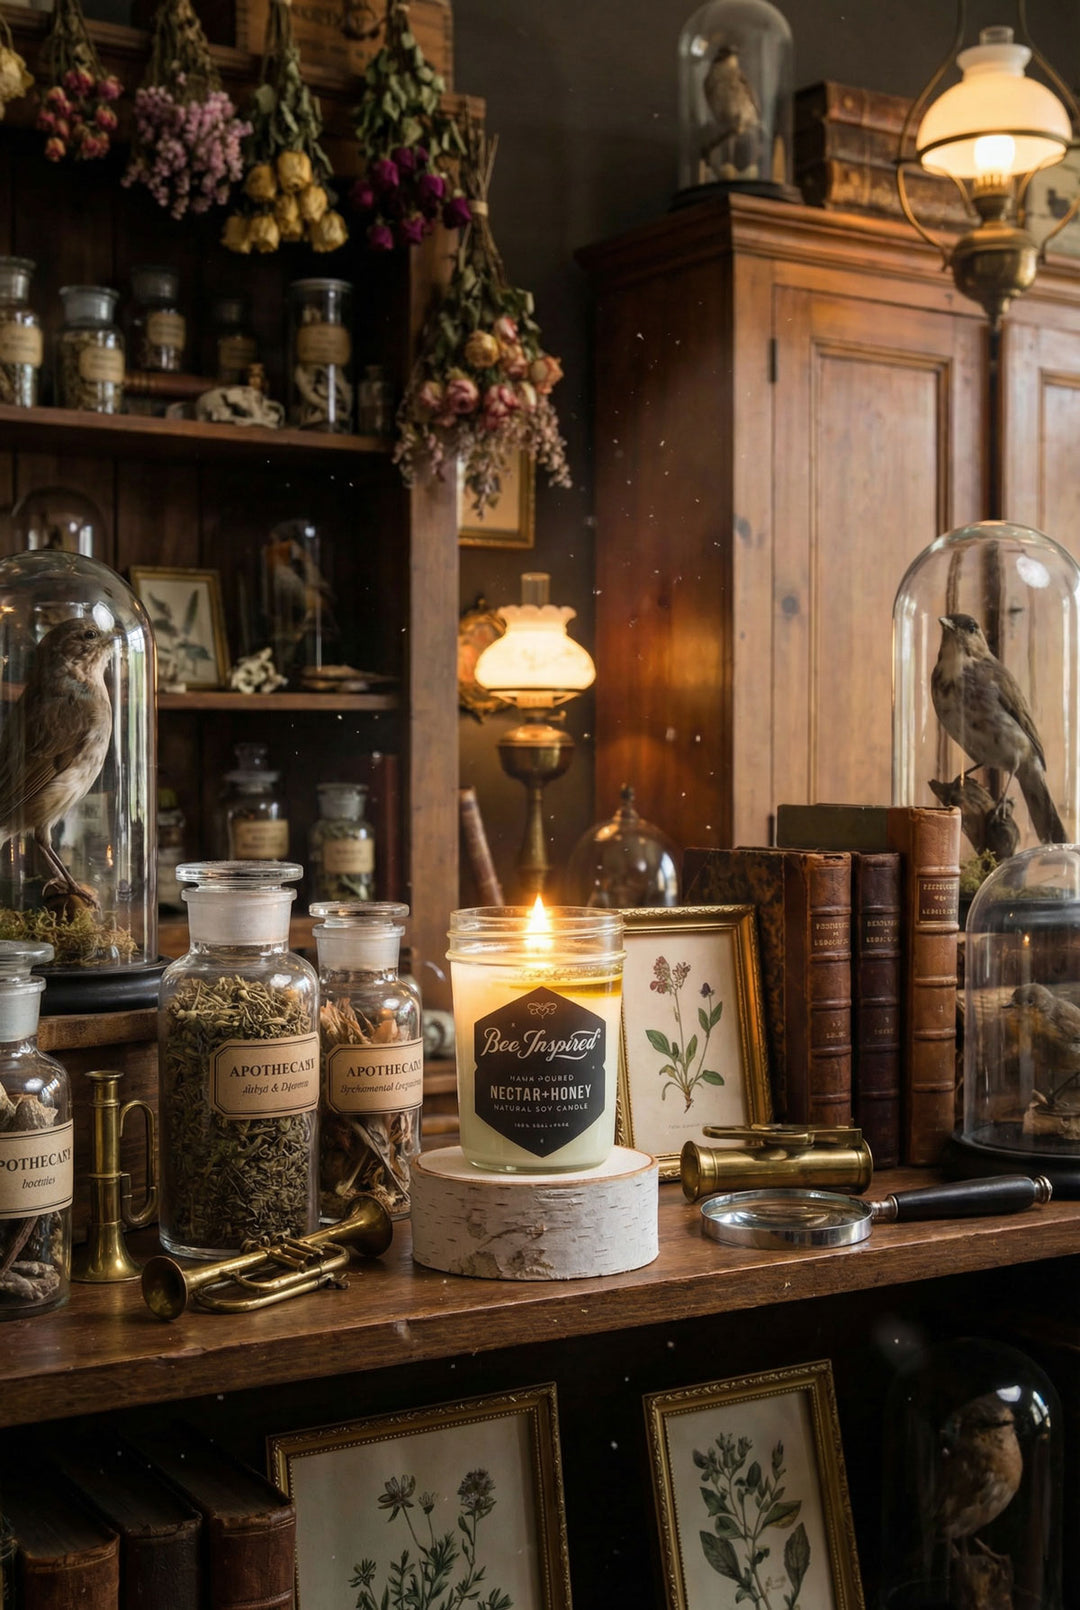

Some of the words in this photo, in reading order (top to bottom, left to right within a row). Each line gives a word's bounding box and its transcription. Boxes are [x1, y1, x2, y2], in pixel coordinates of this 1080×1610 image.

[480, 1027, 520, 1057] Bee
[517, 1028, 602, 1062] Inspired
[493, 1104, 532, 1113] NATURAL
[535, 1105, 553, 1113] SOY
[556, 1103, 588, 1112] CANDLE
